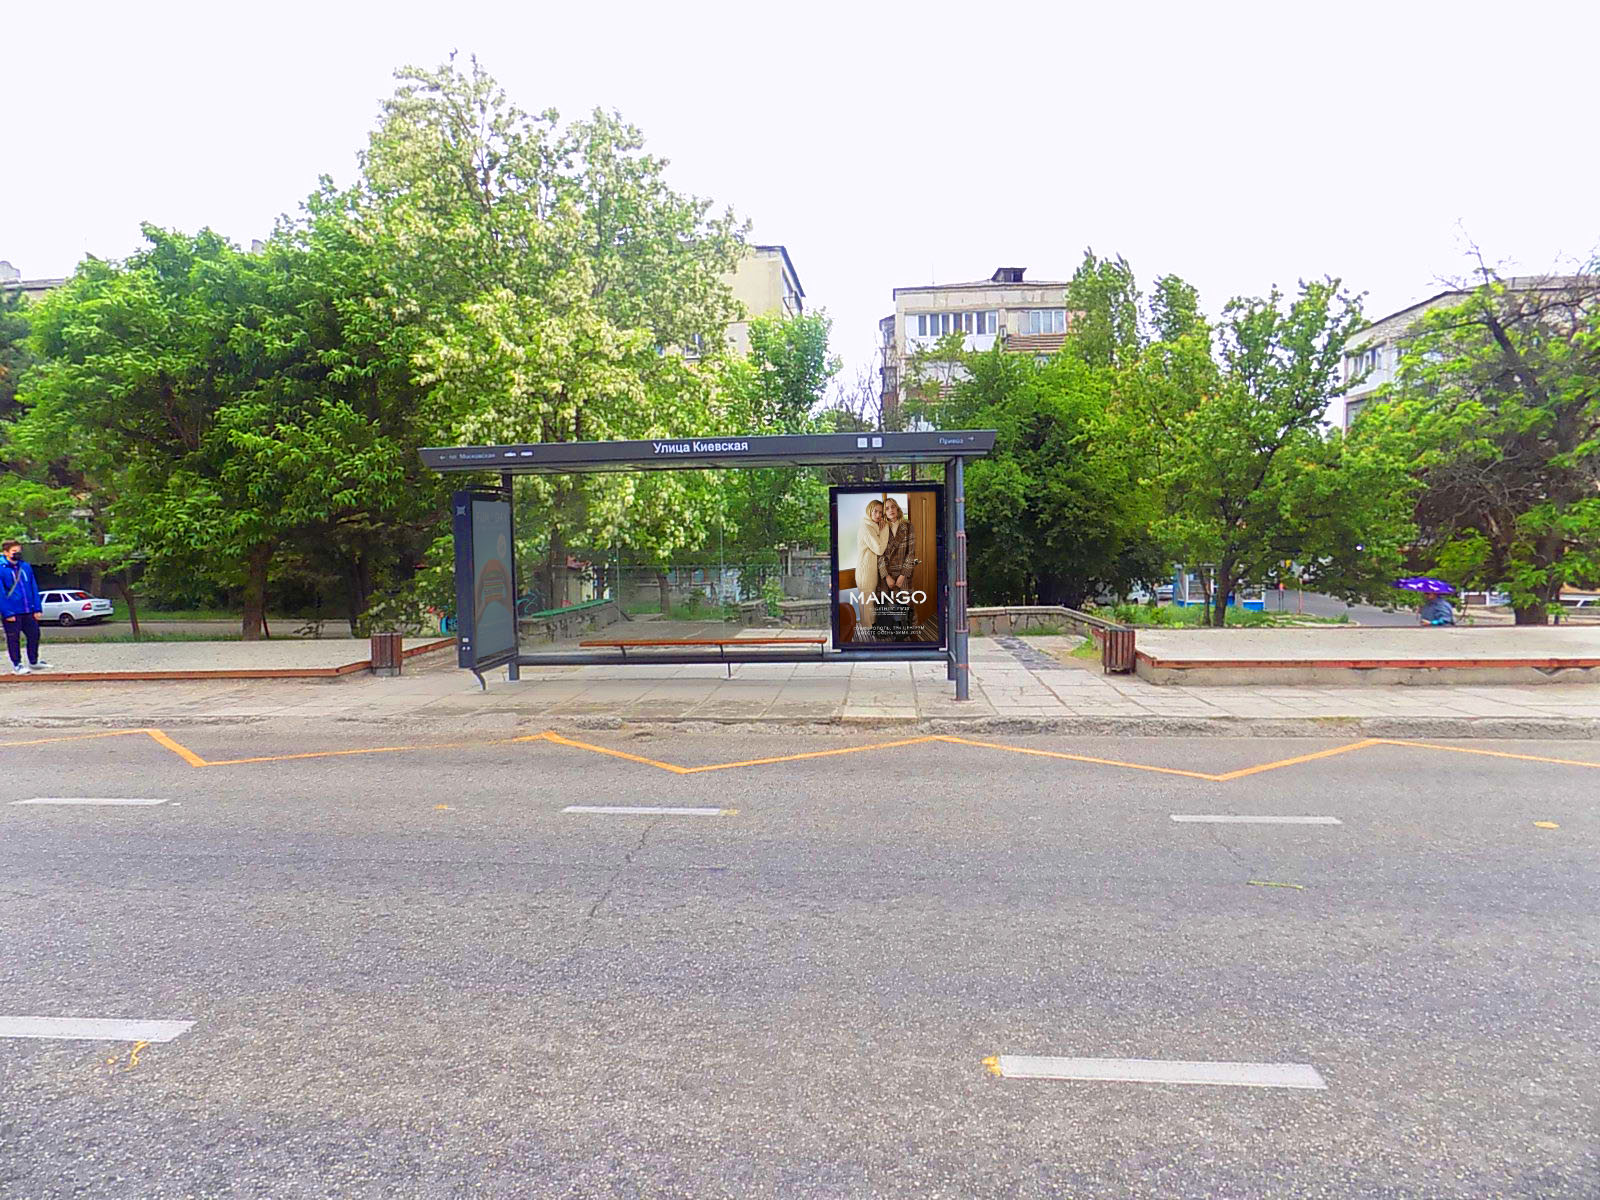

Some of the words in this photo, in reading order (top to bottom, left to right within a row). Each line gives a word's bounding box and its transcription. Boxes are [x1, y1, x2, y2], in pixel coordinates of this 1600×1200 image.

[652, 442, 690, 453] Улица
[692, 441, 748, 452] Киевская
[849, 590, 928, 605] MANGO
